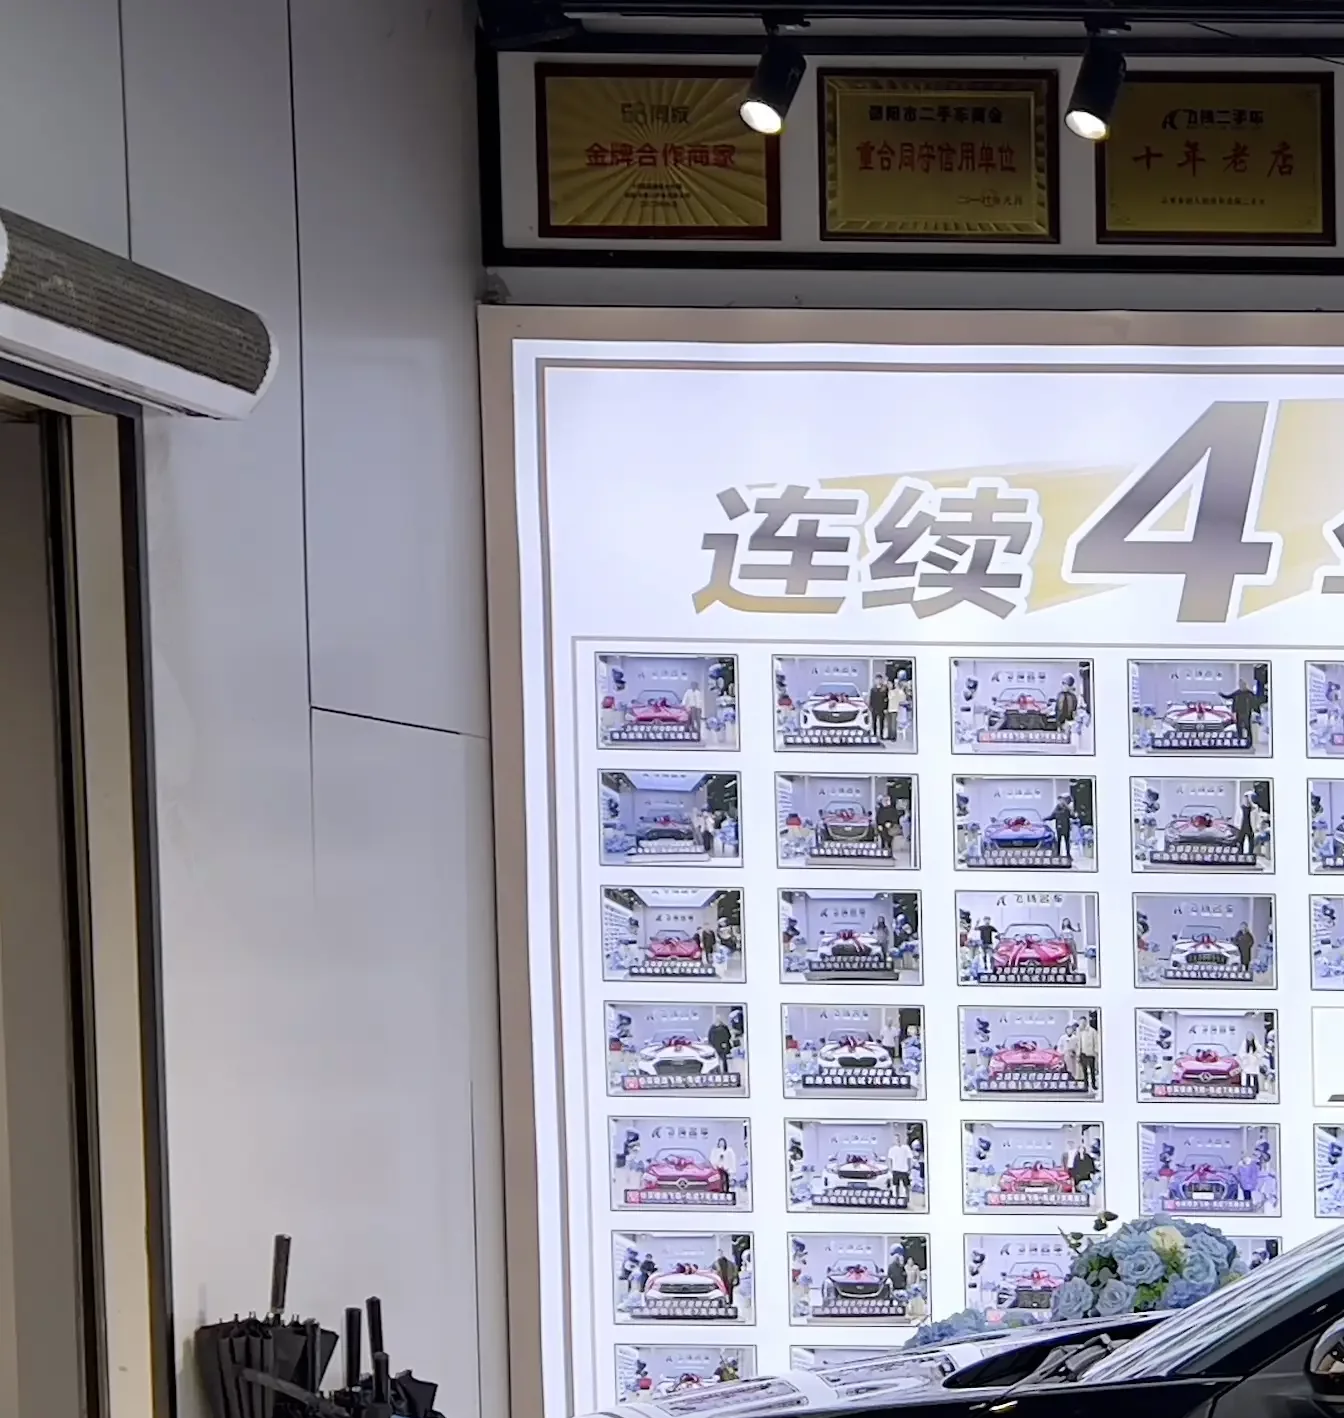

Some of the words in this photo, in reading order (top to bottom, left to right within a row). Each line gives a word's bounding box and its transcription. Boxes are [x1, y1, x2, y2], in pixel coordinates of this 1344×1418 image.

[585, 142, 736, 167] 金牌合作商家
[857, 140, 1016, 173] 重合同守信用单位
[1132, 139, 1295, 177] 十年老店
